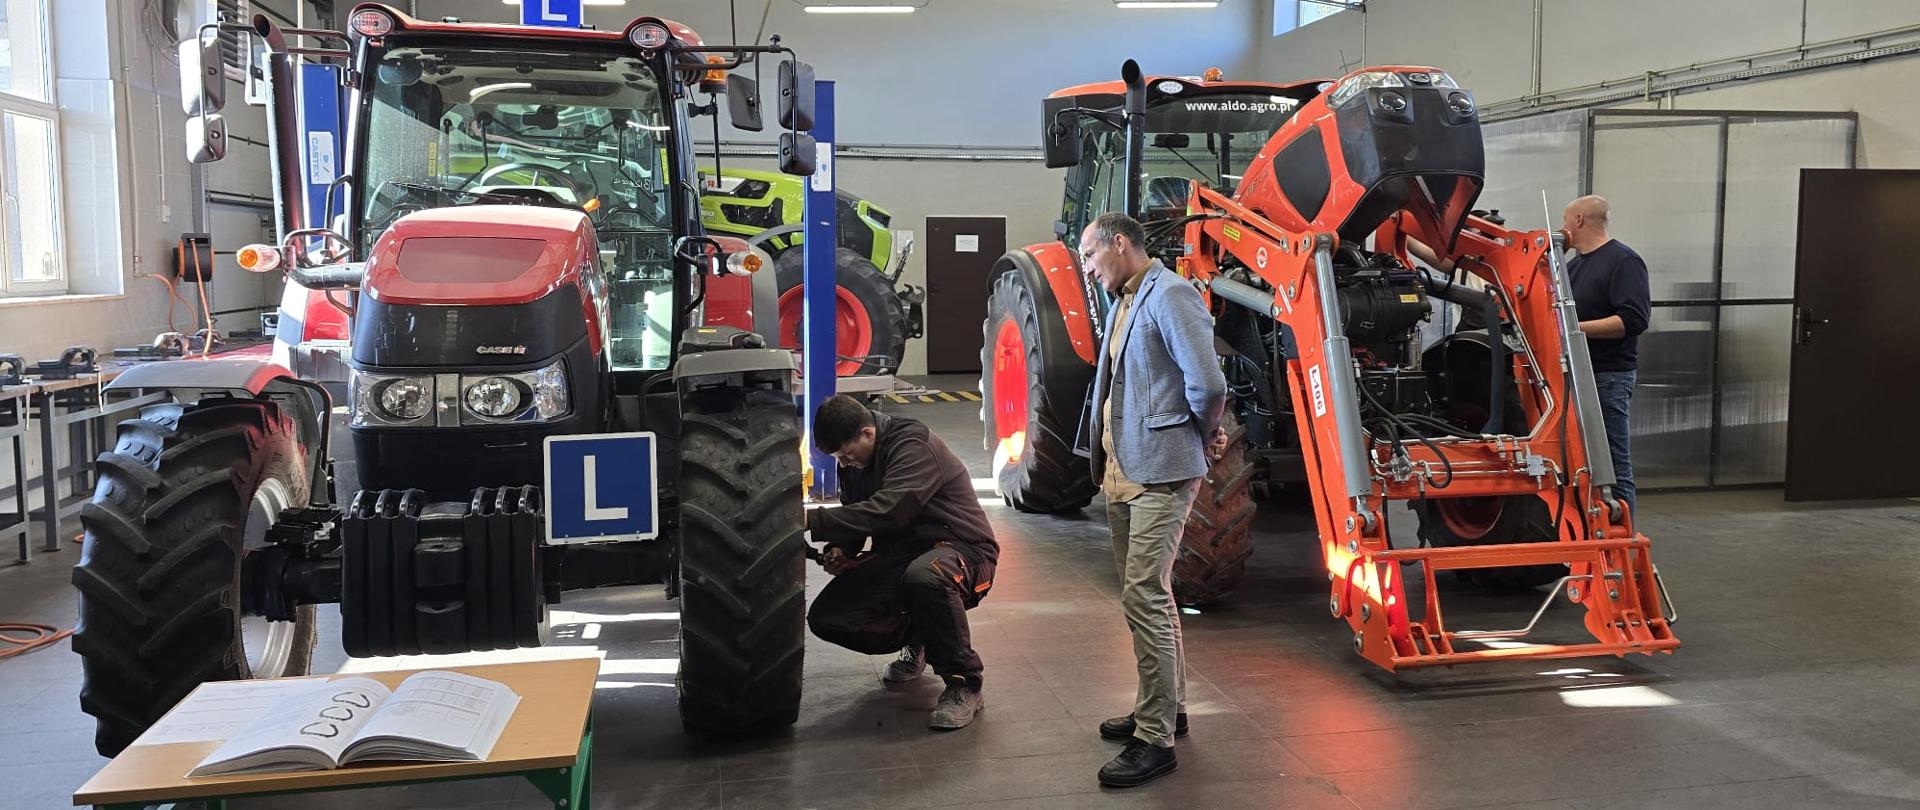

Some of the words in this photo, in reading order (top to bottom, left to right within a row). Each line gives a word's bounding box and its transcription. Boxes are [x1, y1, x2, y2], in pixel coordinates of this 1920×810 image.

[1185, 100, 1291, 113] www.aldo.agro.pl
[311, 137, 319, 177] CASTEX
[476, 345, 512, 354] CASE
[583, 454, 628, 520] L
